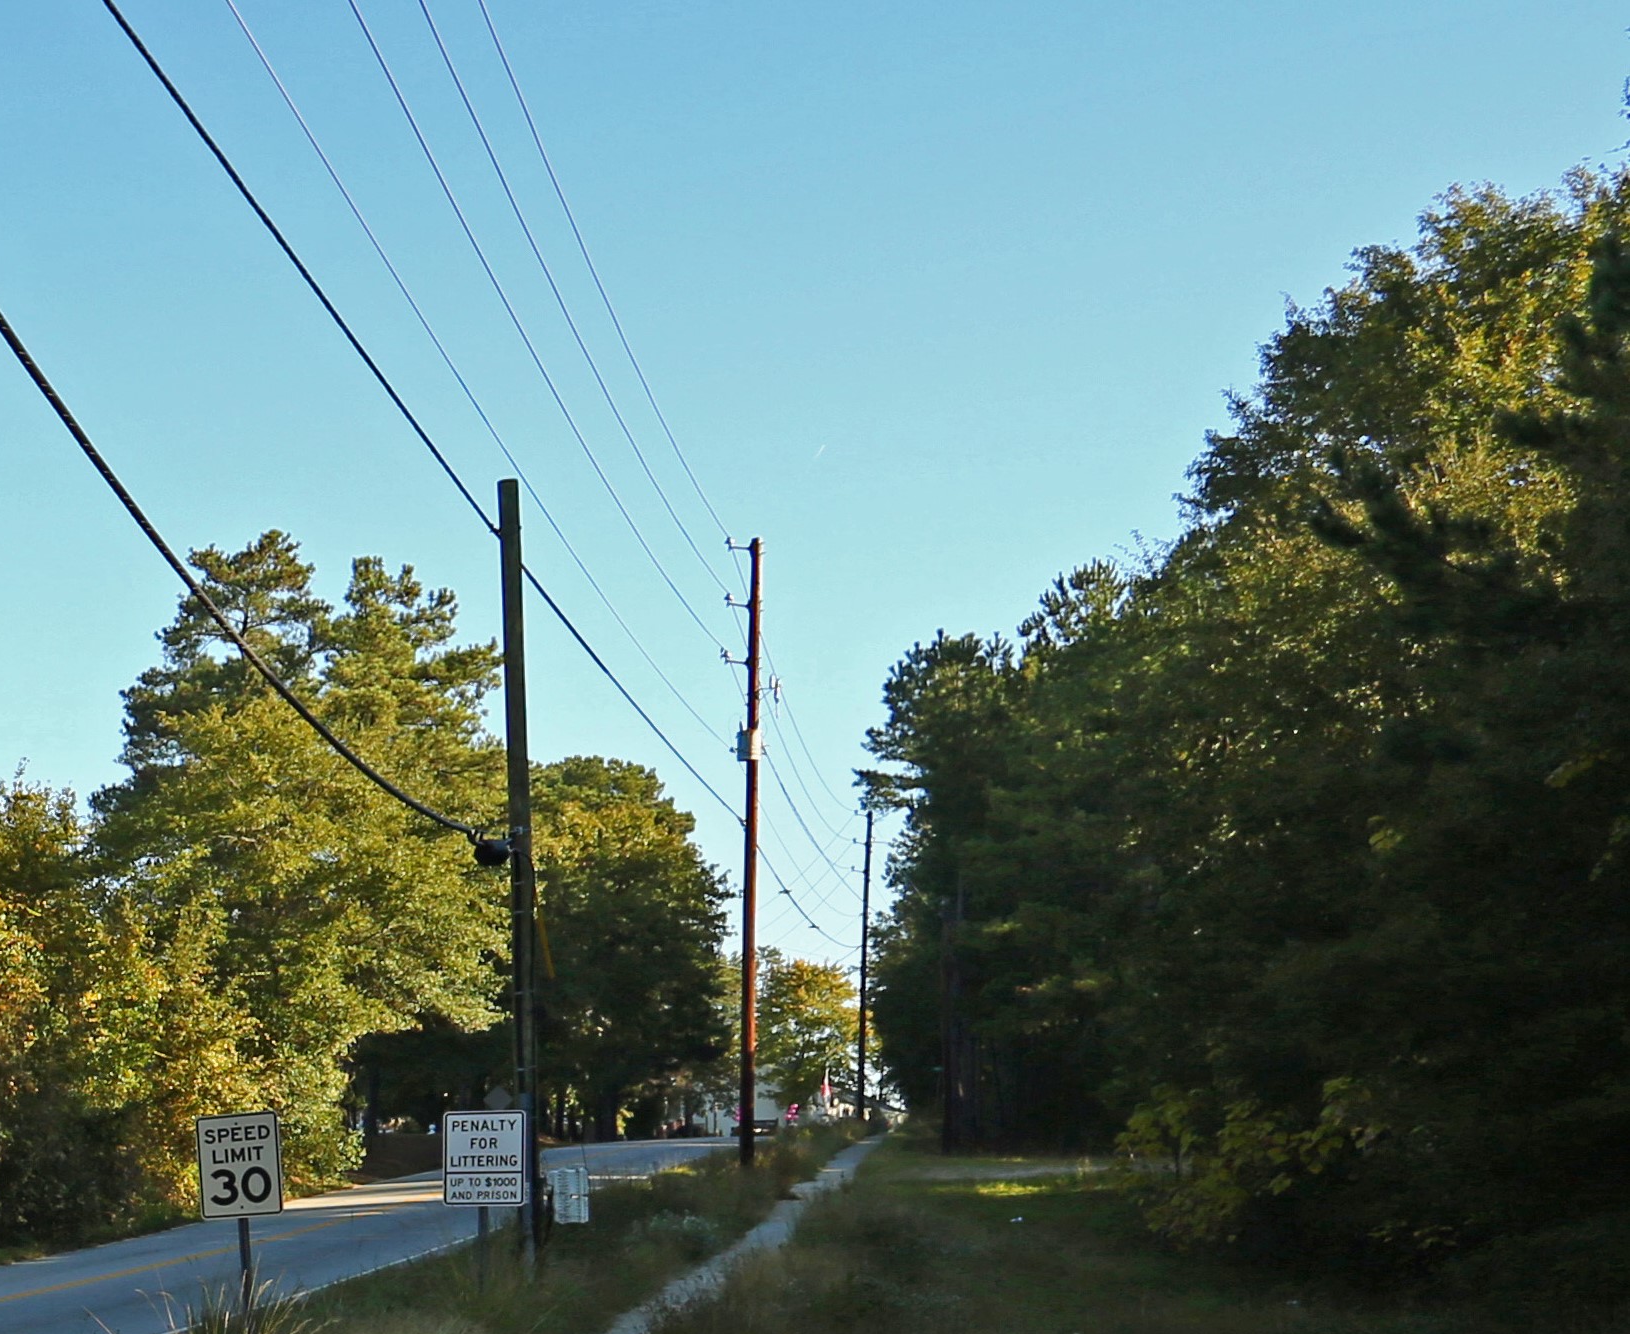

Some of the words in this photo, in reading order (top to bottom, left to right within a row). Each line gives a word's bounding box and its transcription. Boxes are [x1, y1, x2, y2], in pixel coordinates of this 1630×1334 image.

[451, 1119, 517, 1132] PENALTY
[204, 1125, 271, 1144] SPEED
[470, 1137, 498, 1149] FOR
[212, 1146, 264, 1164] LIMIT
[450, 1155, 518, 1167] LITTERING
[210, 1166, 272, 1206] 30
[450, 1178, 464, 1187] UP
[468, 1178, 481, 1187] TO
[485, 1177, 517, 1187] $1000
[451, 1191, 472, 1200] AND
[477, 1190, 517, 1200] PRISON
